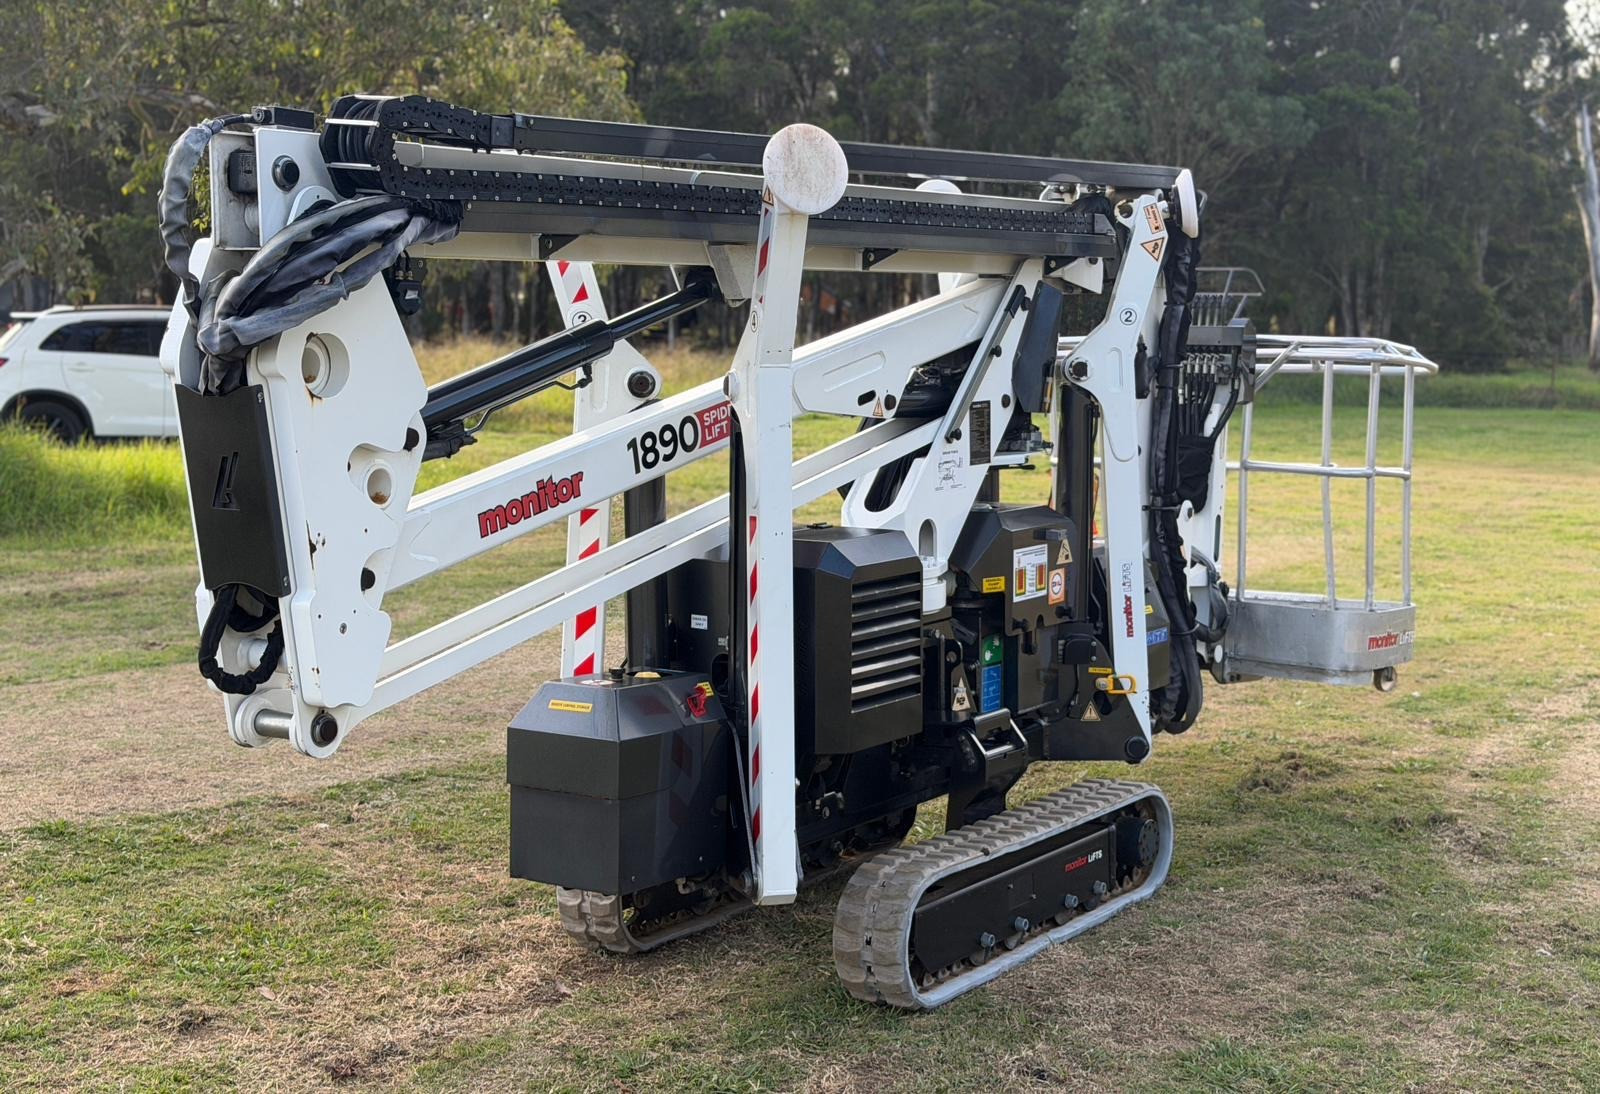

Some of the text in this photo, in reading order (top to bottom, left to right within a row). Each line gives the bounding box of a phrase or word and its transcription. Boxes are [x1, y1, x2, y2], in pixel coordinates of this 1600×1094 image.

[1124, 310, 1133, 322] 2
[705, 421, 728, 440] LIFT
[627, 415, 699, 474] 1890
[478, 471, 583, 538] monitor
[1123, 594, 1134, 638] monitor
[1367, 631, 1398, 651] monitor
[1065, 855, 1088, 872] monitor
